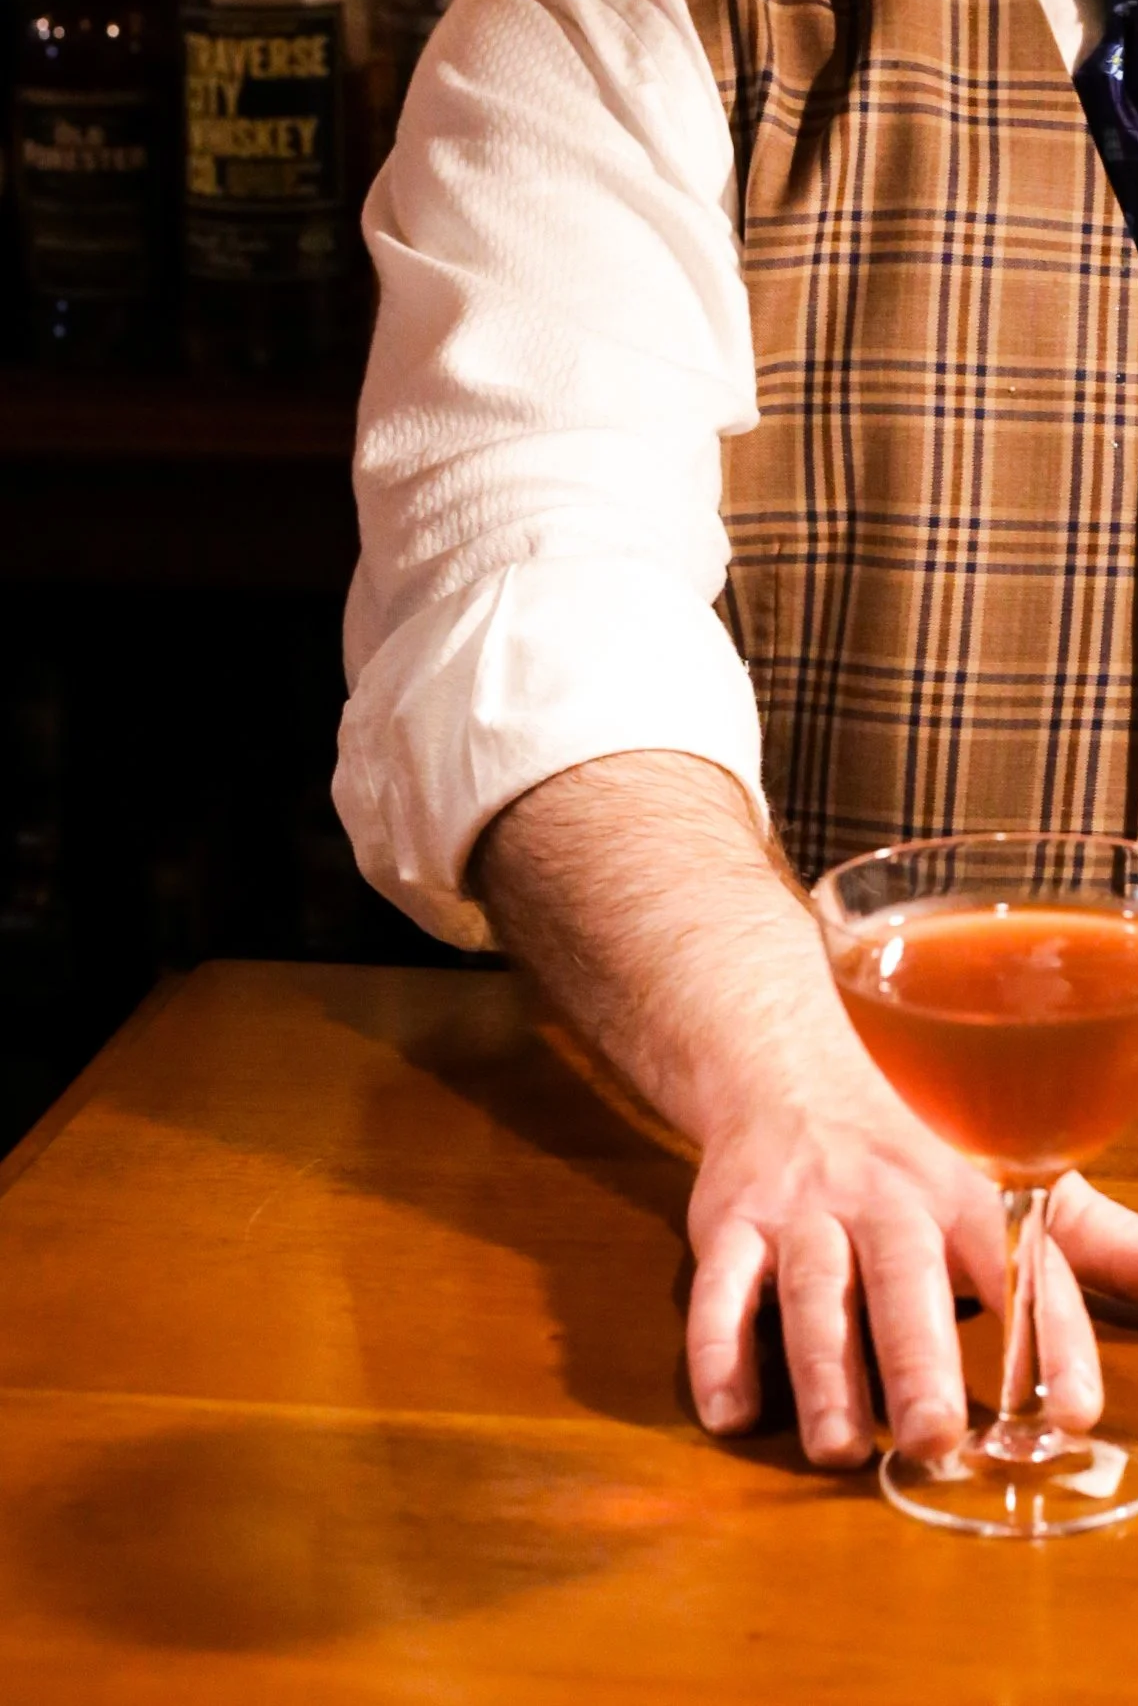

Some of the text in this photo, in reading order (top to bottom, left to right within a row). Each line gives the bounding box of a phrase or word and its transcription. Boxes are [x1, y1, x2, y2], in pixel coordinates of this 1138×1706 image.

[185, 32, 331, 78] TRAVERSE
[185, 75, 244, 118] CITY
[186, 114, 319, 159] WHISKEY
